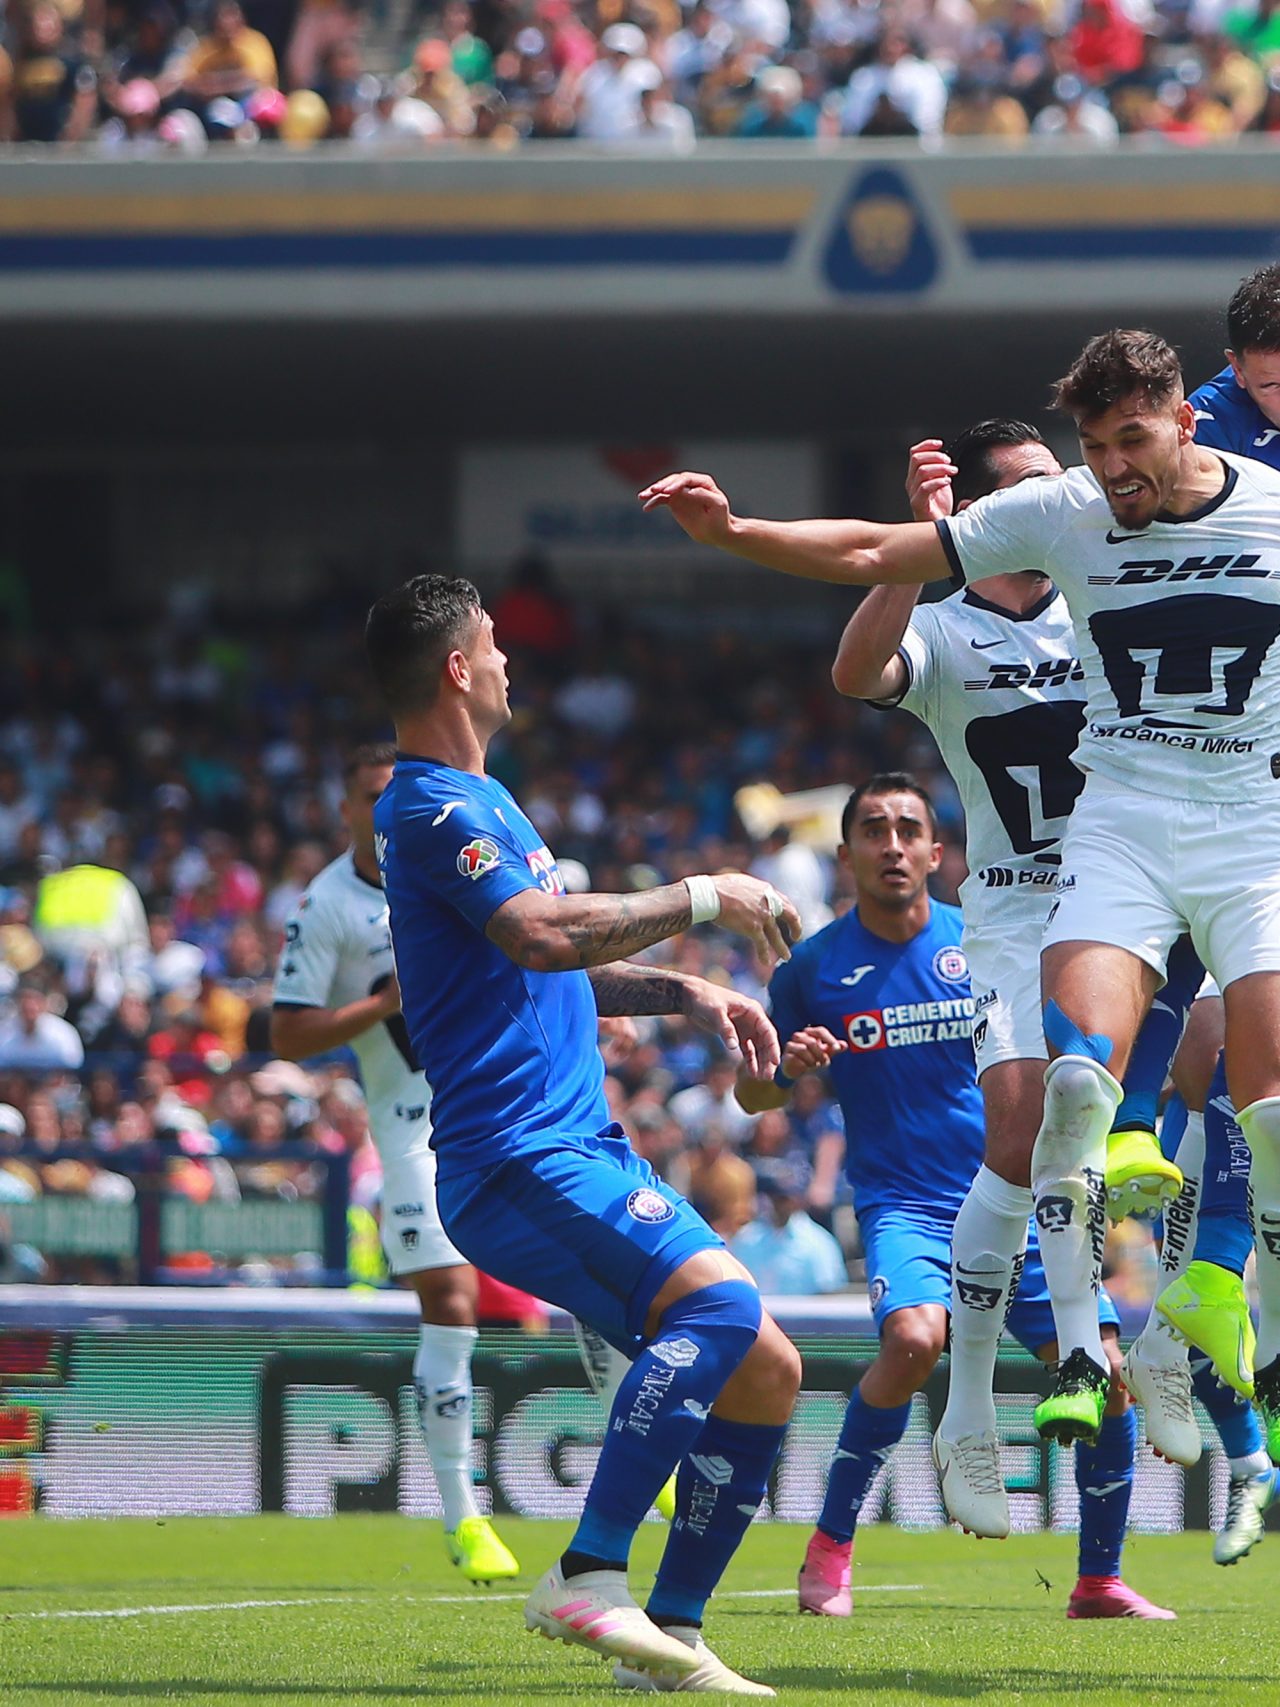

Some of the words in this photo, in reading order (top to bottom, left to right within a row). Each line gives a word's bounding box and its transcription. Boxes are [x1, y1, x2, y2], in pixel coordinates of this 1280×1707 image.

[1114, 554, 1271, 585] DHL
[1120, 728, 1197, 750] Banca
[882, 997, 976, 1027] CEMENTO
[886, 1023, 935, 1048] CRUZ
[937, 1019, 973, 1042] AZU
